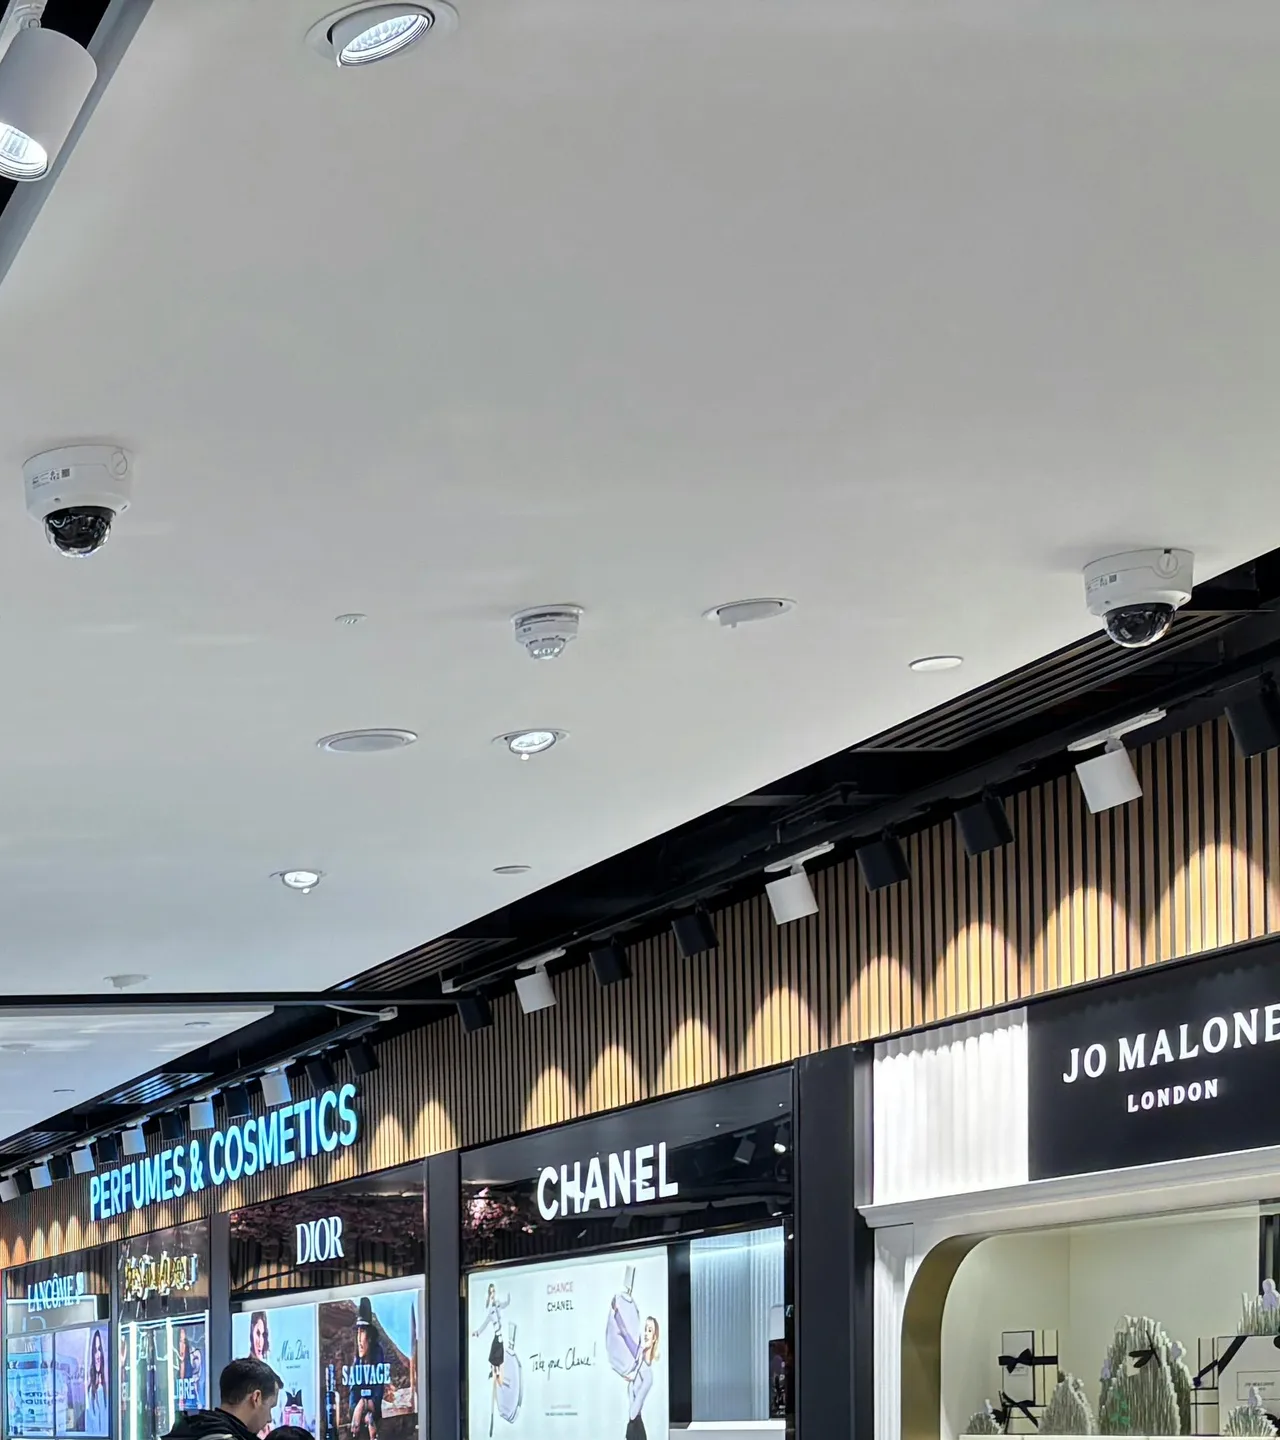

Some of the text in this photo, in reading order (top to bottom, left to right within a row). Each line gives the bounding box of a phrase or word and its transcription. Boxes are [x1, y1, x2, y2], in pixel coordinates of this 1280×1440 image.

[1062, 1002, 1280, 1083] JO MALONE
[1127, 1078, 1218, 1113] LONDON
[90, 1083, 359, 1221] PERFUMES & COSMETICS
[537, 1141, 679, 1221] CHANEL
[295, 1216, 345, 1265] DIOR
[27, 1273, 76, 1313] LANCÔME
[546, 1281, 573, 1294] CHANCE
[547, 1300, 574, 1312] CHANEL
[341, 1363, 391, 1386] SAUVAGE
